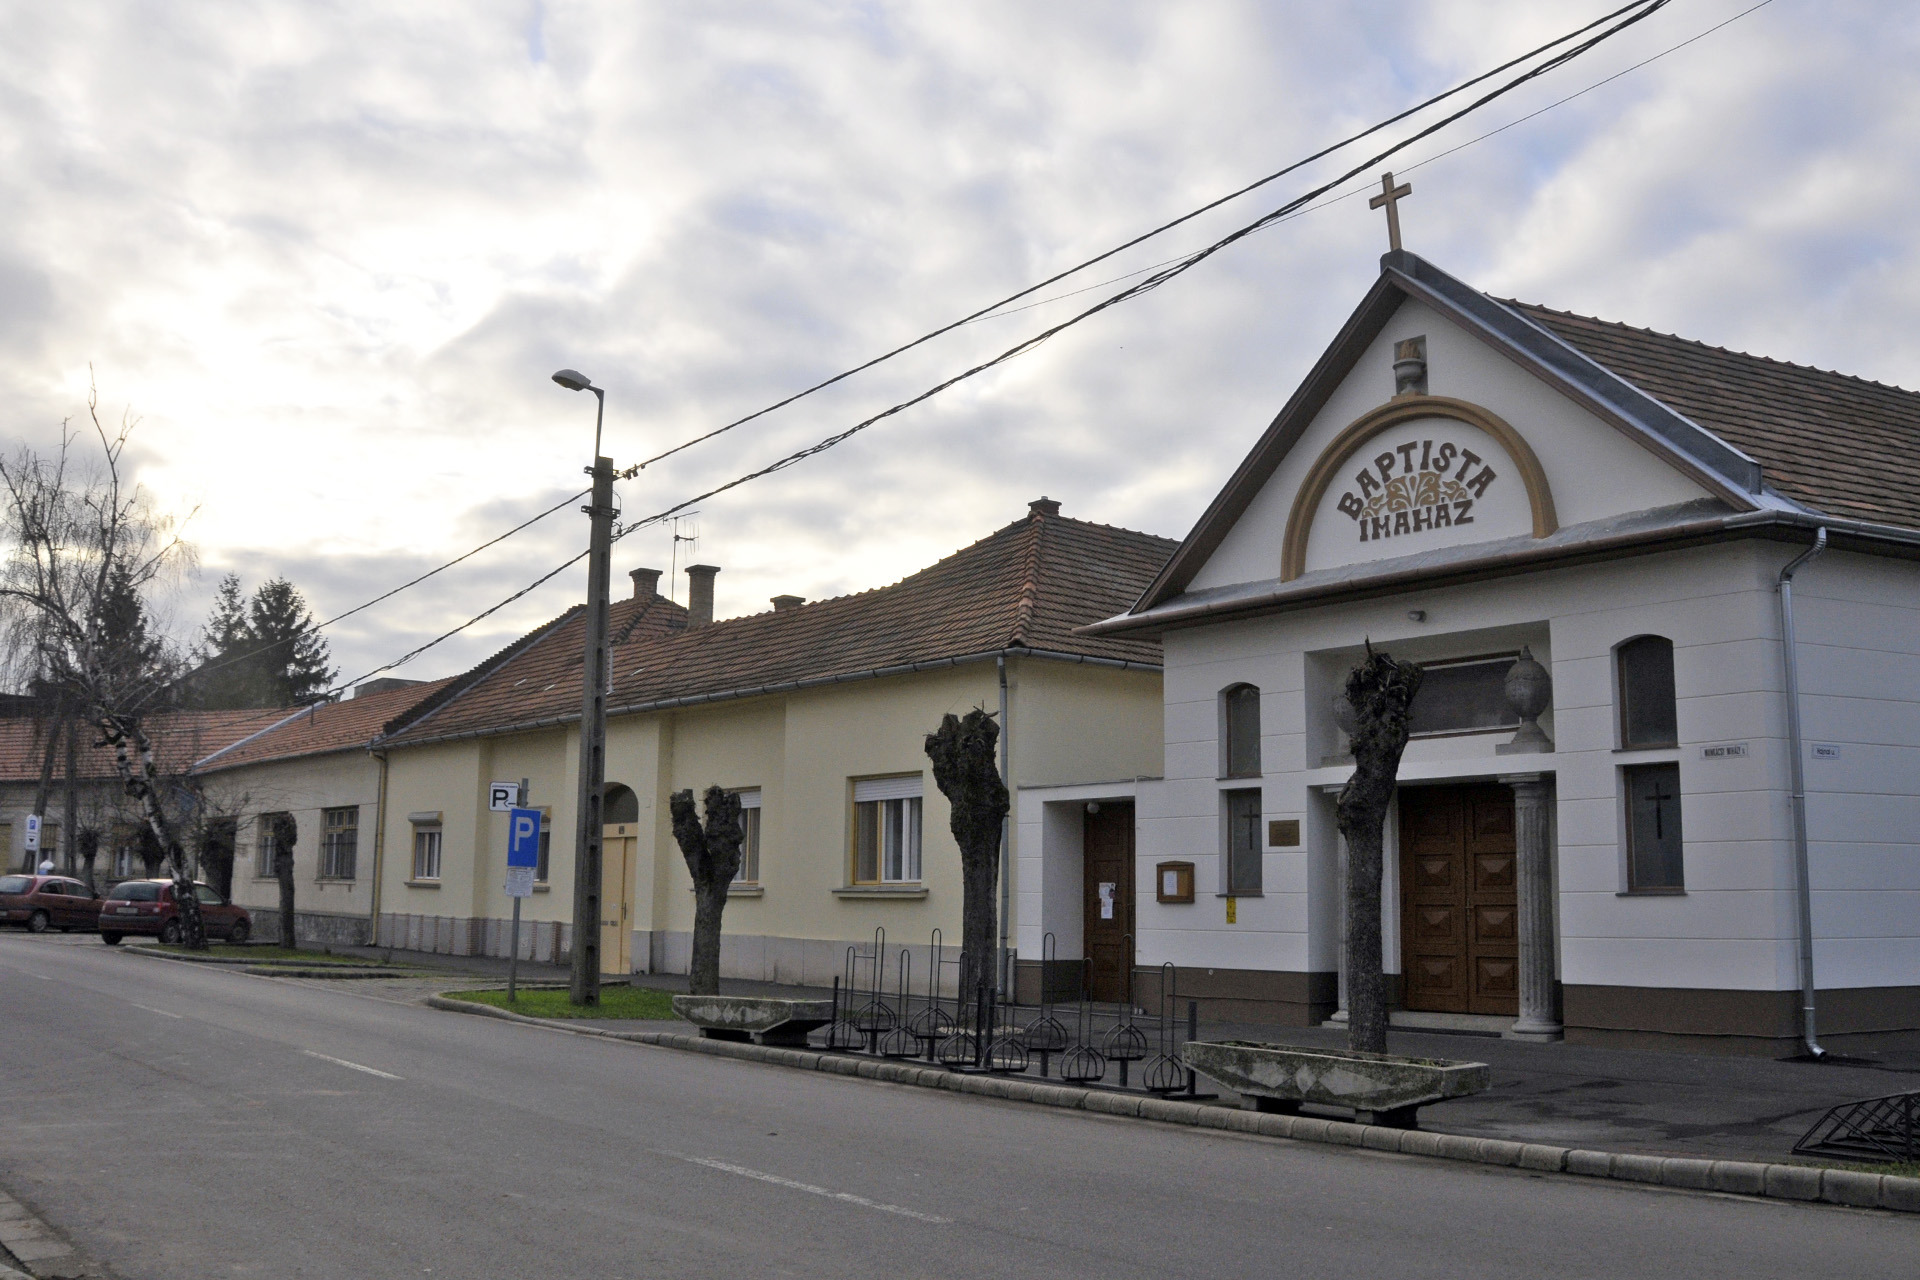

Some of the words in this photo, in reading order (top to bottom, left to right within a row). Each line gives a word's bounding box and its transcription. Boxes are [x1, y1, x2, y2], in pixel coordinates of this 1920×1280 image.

[1337, 440, 1497, 521] BAPTISTA
[1359, 497, 1475, 542] IMAHÁZ
[493, 789, 509, 807] P
[514, 817, 534, 851] P
